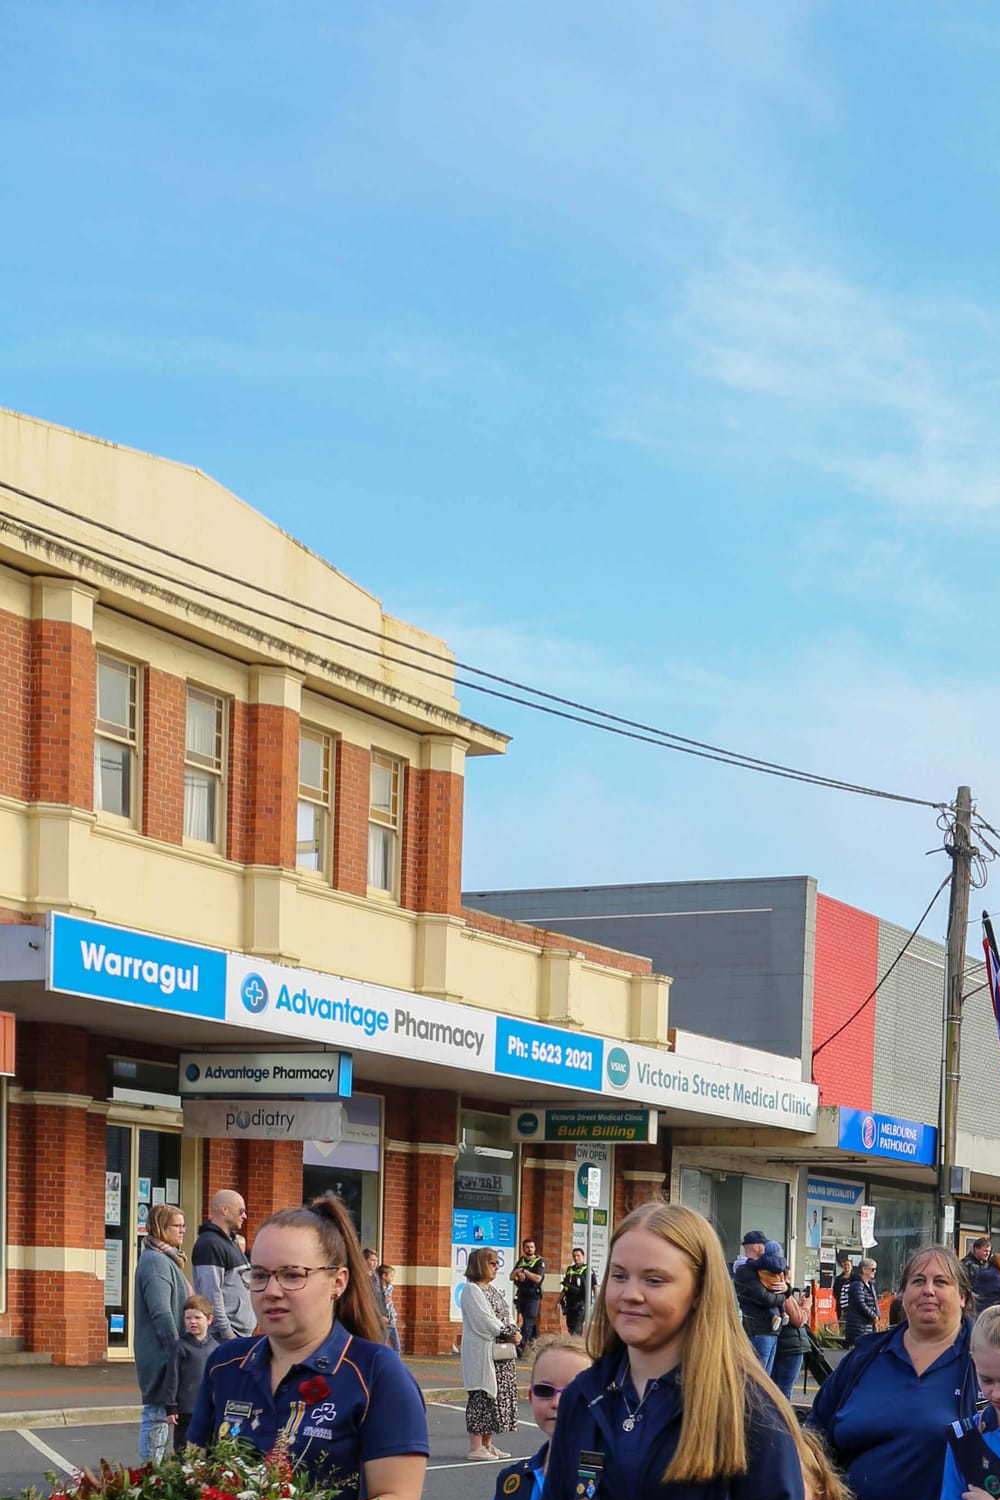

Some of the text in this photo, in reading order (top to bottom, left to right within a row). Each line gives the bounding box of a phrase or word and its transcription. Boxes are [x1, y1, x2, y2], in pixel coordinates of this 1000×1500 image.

[80, 940, 199, 994] Warragul
[276, 984, 485, 1056] Advantage Pharmacy
[508, 1035, 593, 1072] Ph: 5623 2021
[205, 1066, 334, 1082] Advantage Pharmacy
[610, 1061, 627, 1073] VSMC
[637, 1061, 811, 1117] Victoria Street Medical Clinic
[557, 1125, 636, 1139] Bulk Billing
[880, 1123, 918, 1140] MELBOURNE
[879, 1137, 917, 1155] PATHOLOGY
[588, 1150, 607, 1161] OPEN
